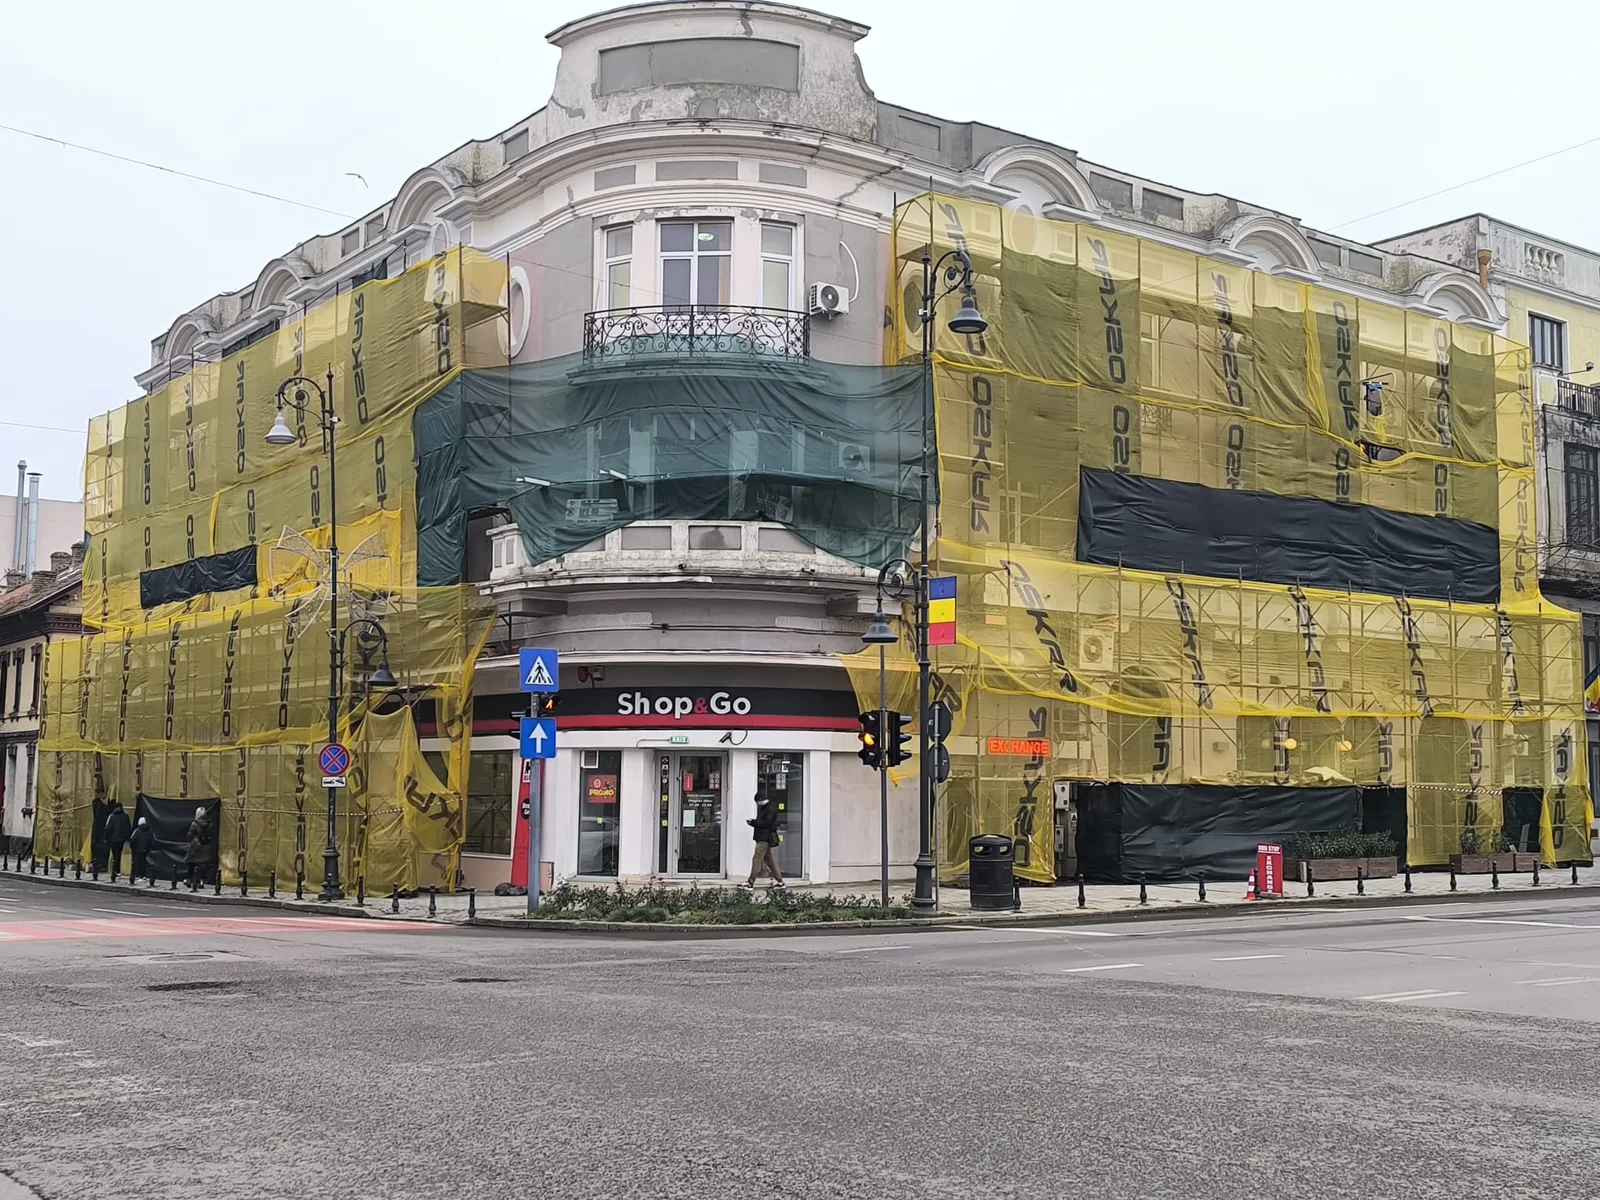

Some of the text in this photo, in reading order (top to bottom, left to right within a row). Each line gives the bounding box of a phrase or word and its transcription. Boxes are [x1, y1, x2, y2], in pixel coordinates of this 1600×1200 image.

[1000, 559, 1077, 693] OSKAR
[617, 692, 751, 719] Shop&Go
[990, 739, 1049, 754] EXCHANGE
